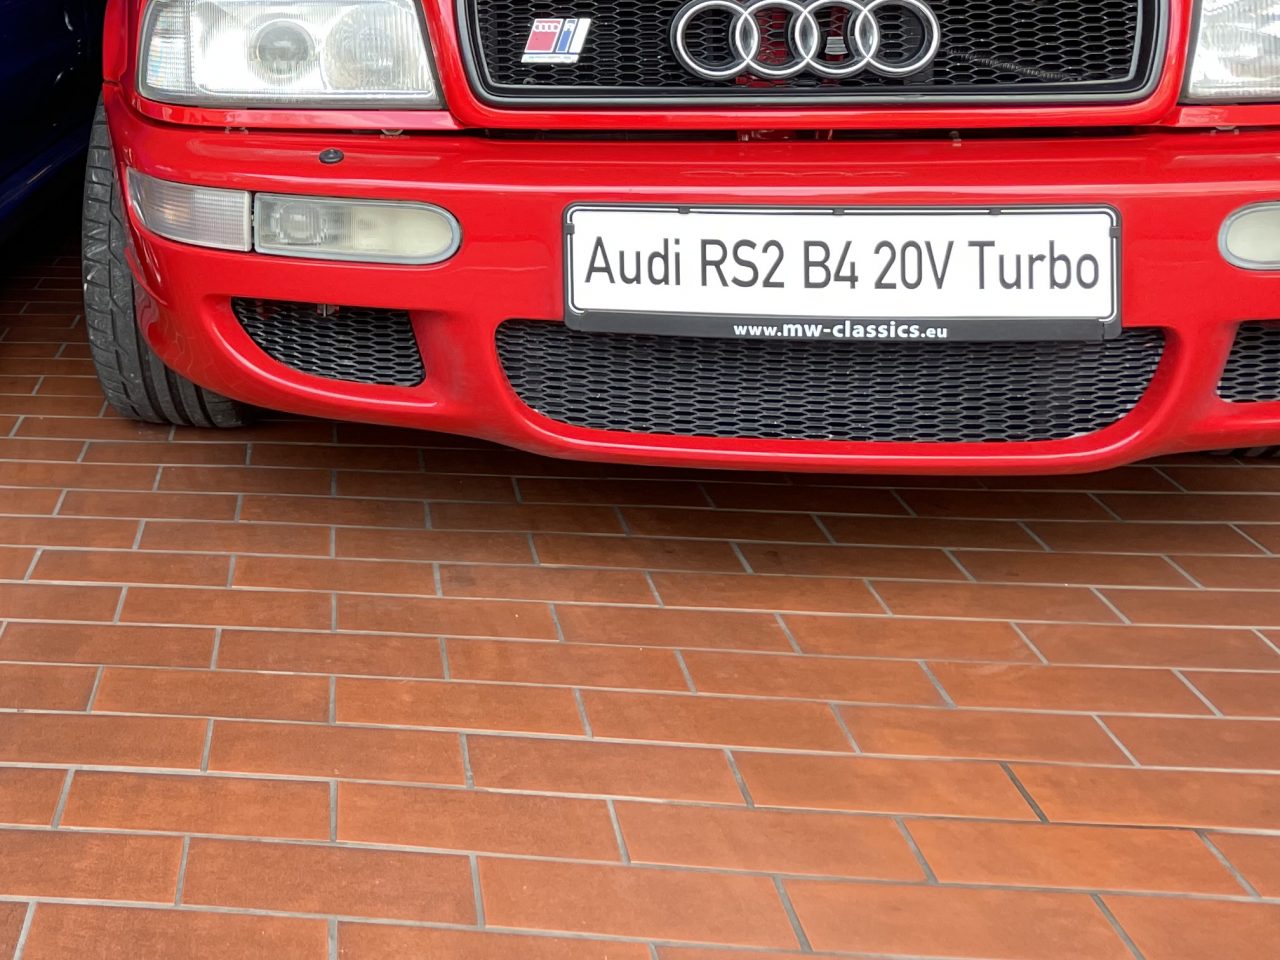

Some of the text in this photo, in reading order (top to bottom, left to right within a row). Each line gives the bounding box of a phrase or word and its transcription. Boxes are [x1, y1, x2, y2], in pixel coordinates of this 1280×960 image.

[584, 236, 1100, 290] Audi RS2 B4 20V Turbo
[733, 320, 948, 340] www.mw-classics.eu
